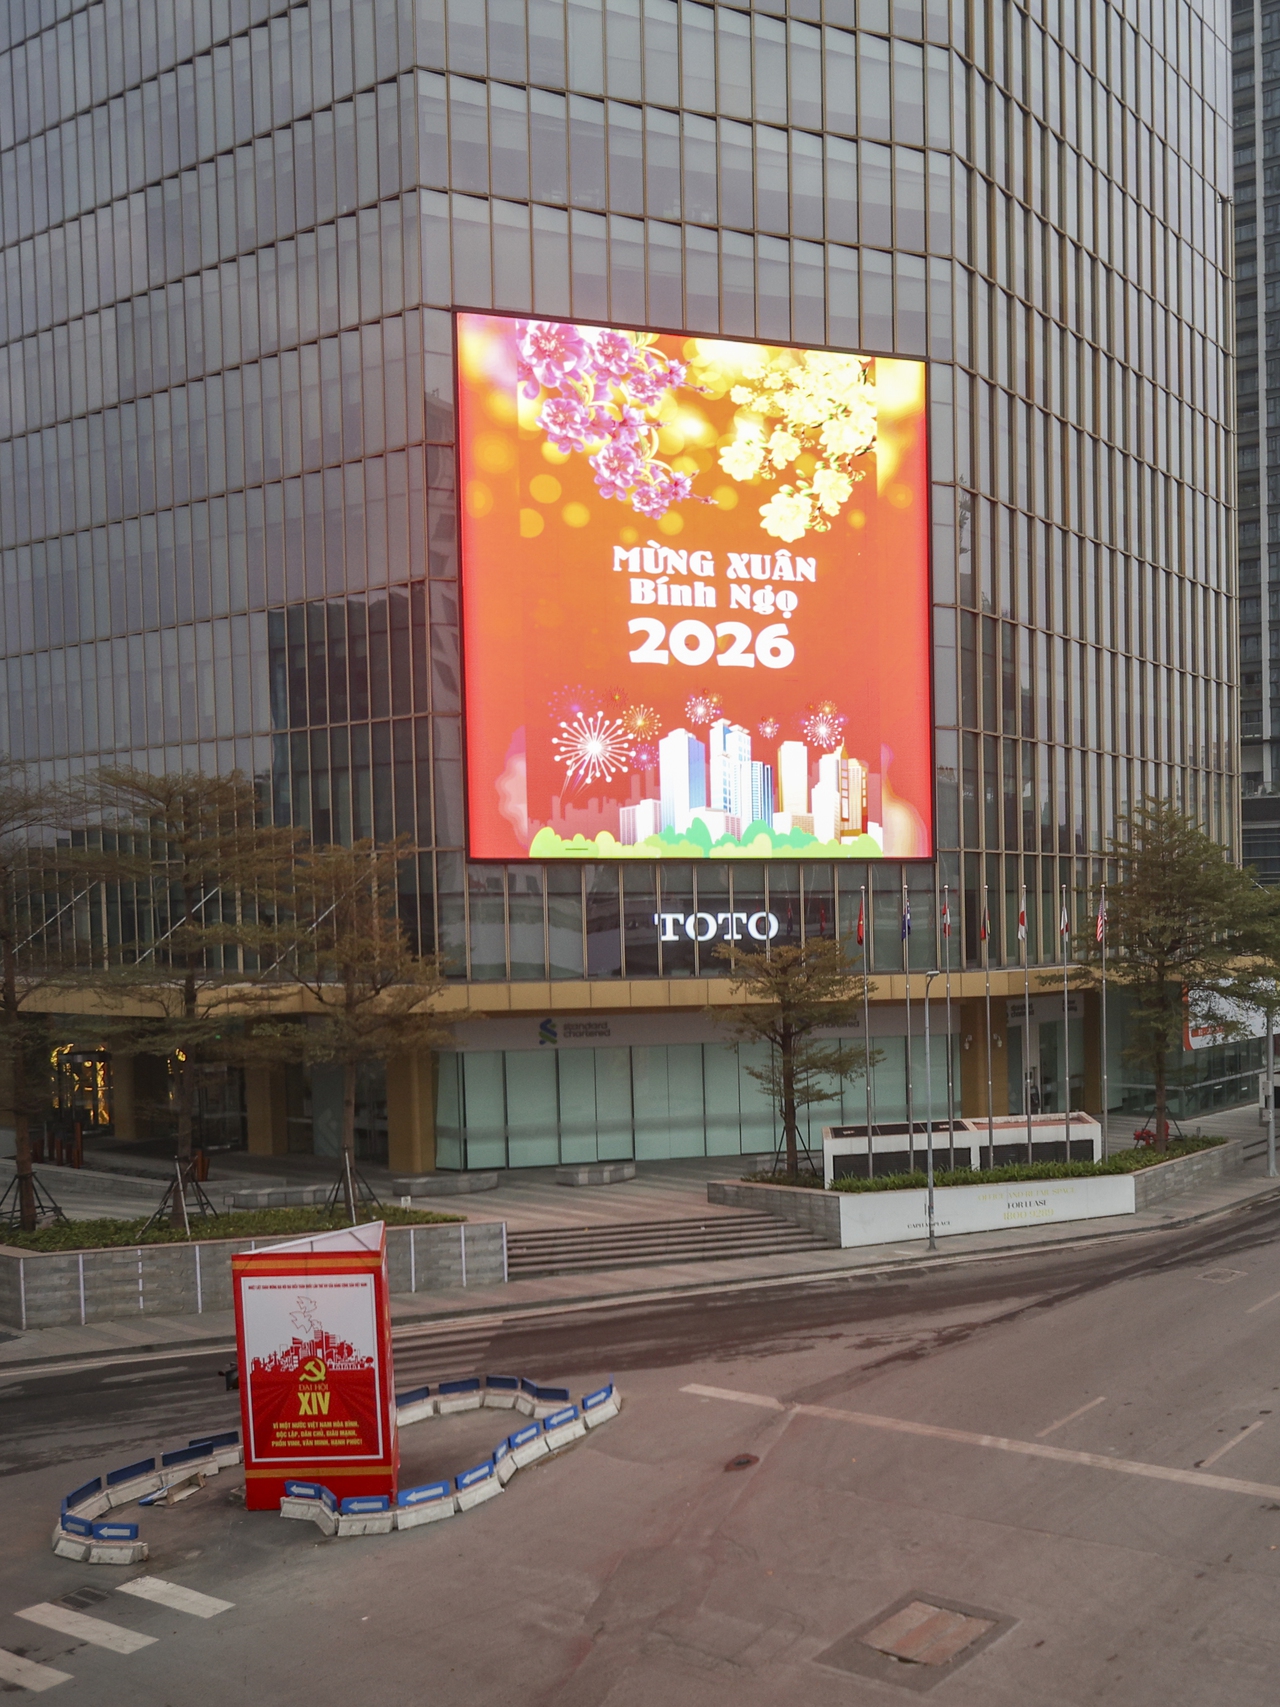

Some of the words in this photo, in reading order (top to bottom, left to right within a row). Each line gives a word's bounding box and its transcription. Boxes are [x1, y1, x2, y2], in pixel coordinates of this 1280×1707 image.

[613, 540, 715, 577] MỪNG
[726, 549, 816, 582] XUÂN
[629, 576, 717, 607] Bính
[729, 583, 798, 619] Ngọ
[628, 617, 795, 669] 2026
[653, 911, 779, 941] TOTO
[563, 1021, 608, 1031] standard
[563, 1028, 611, 1038] chartered
[1003, 1210, 1027, 1220] 1800
[1007, 1201, 1024, 1209] FOR
[297, 1392, 331, 1415] XIV
